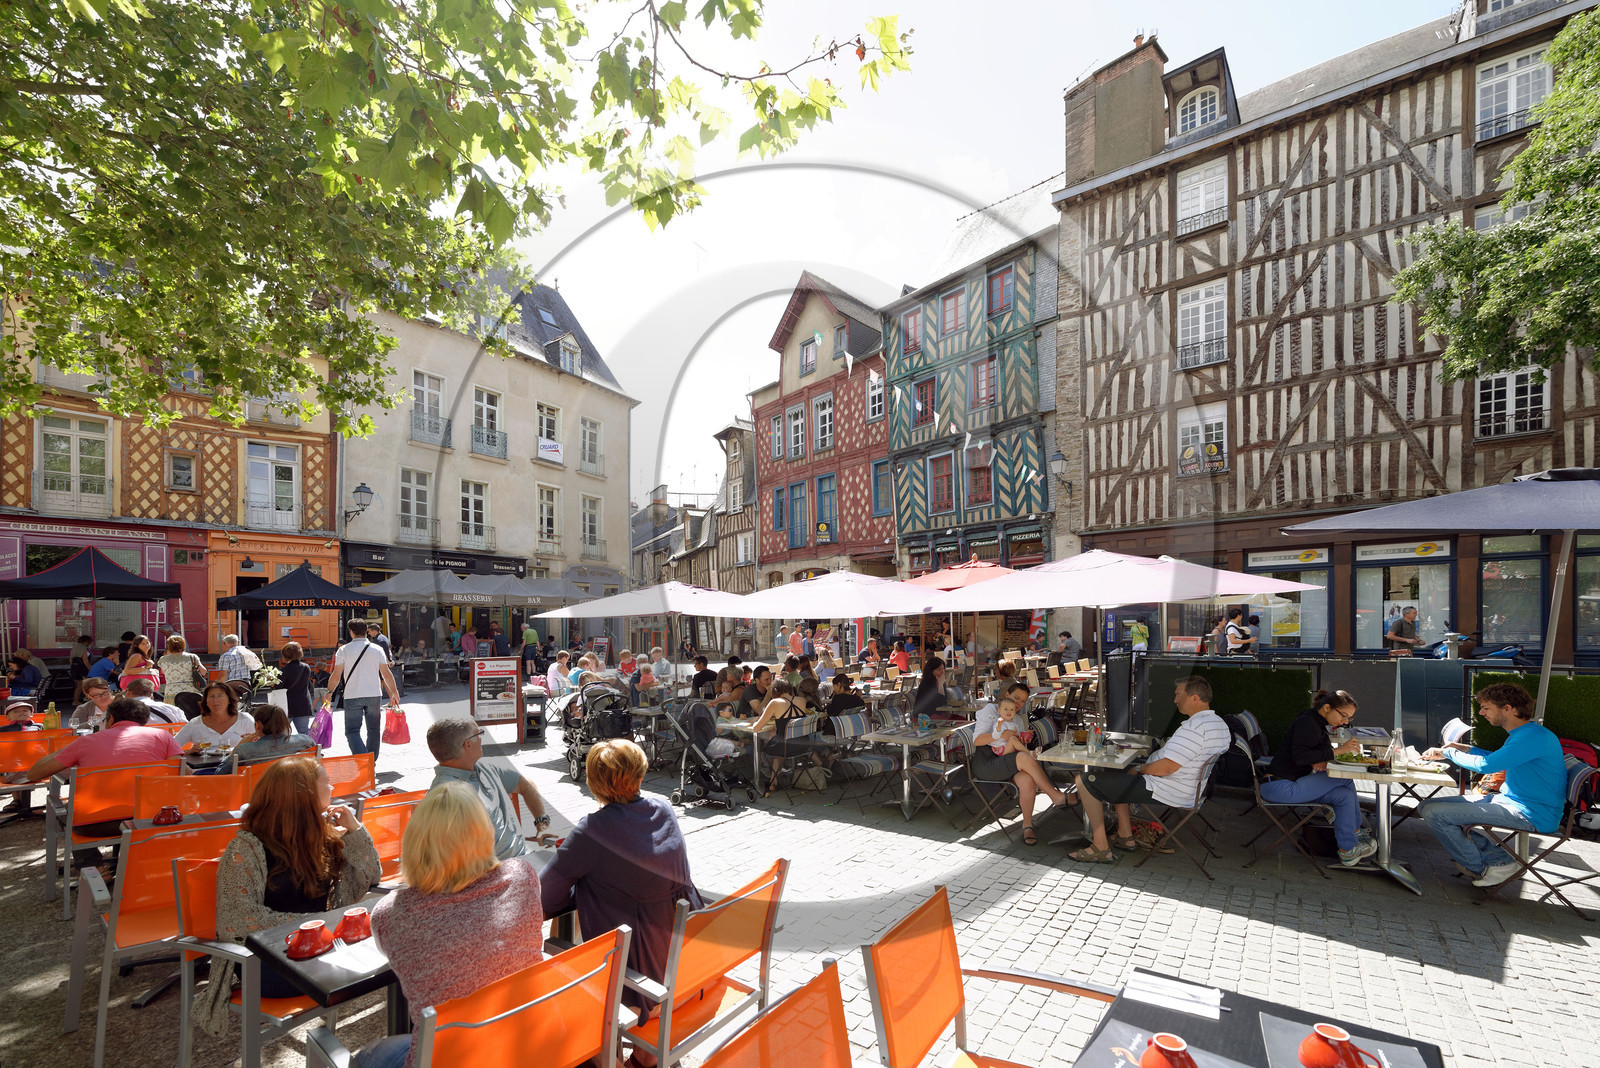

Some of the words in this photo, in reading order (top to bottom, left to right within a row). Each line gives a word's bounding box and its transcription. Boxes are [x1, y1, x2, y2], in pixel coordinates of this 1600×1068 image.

[80, 527, 121, 535] SAINTE
[1012, 533, 1041, 541] PIZZERIA
[265, 599, 316, 607] CREPERIE
[321, 599, 370, 607] PAYSANNE
